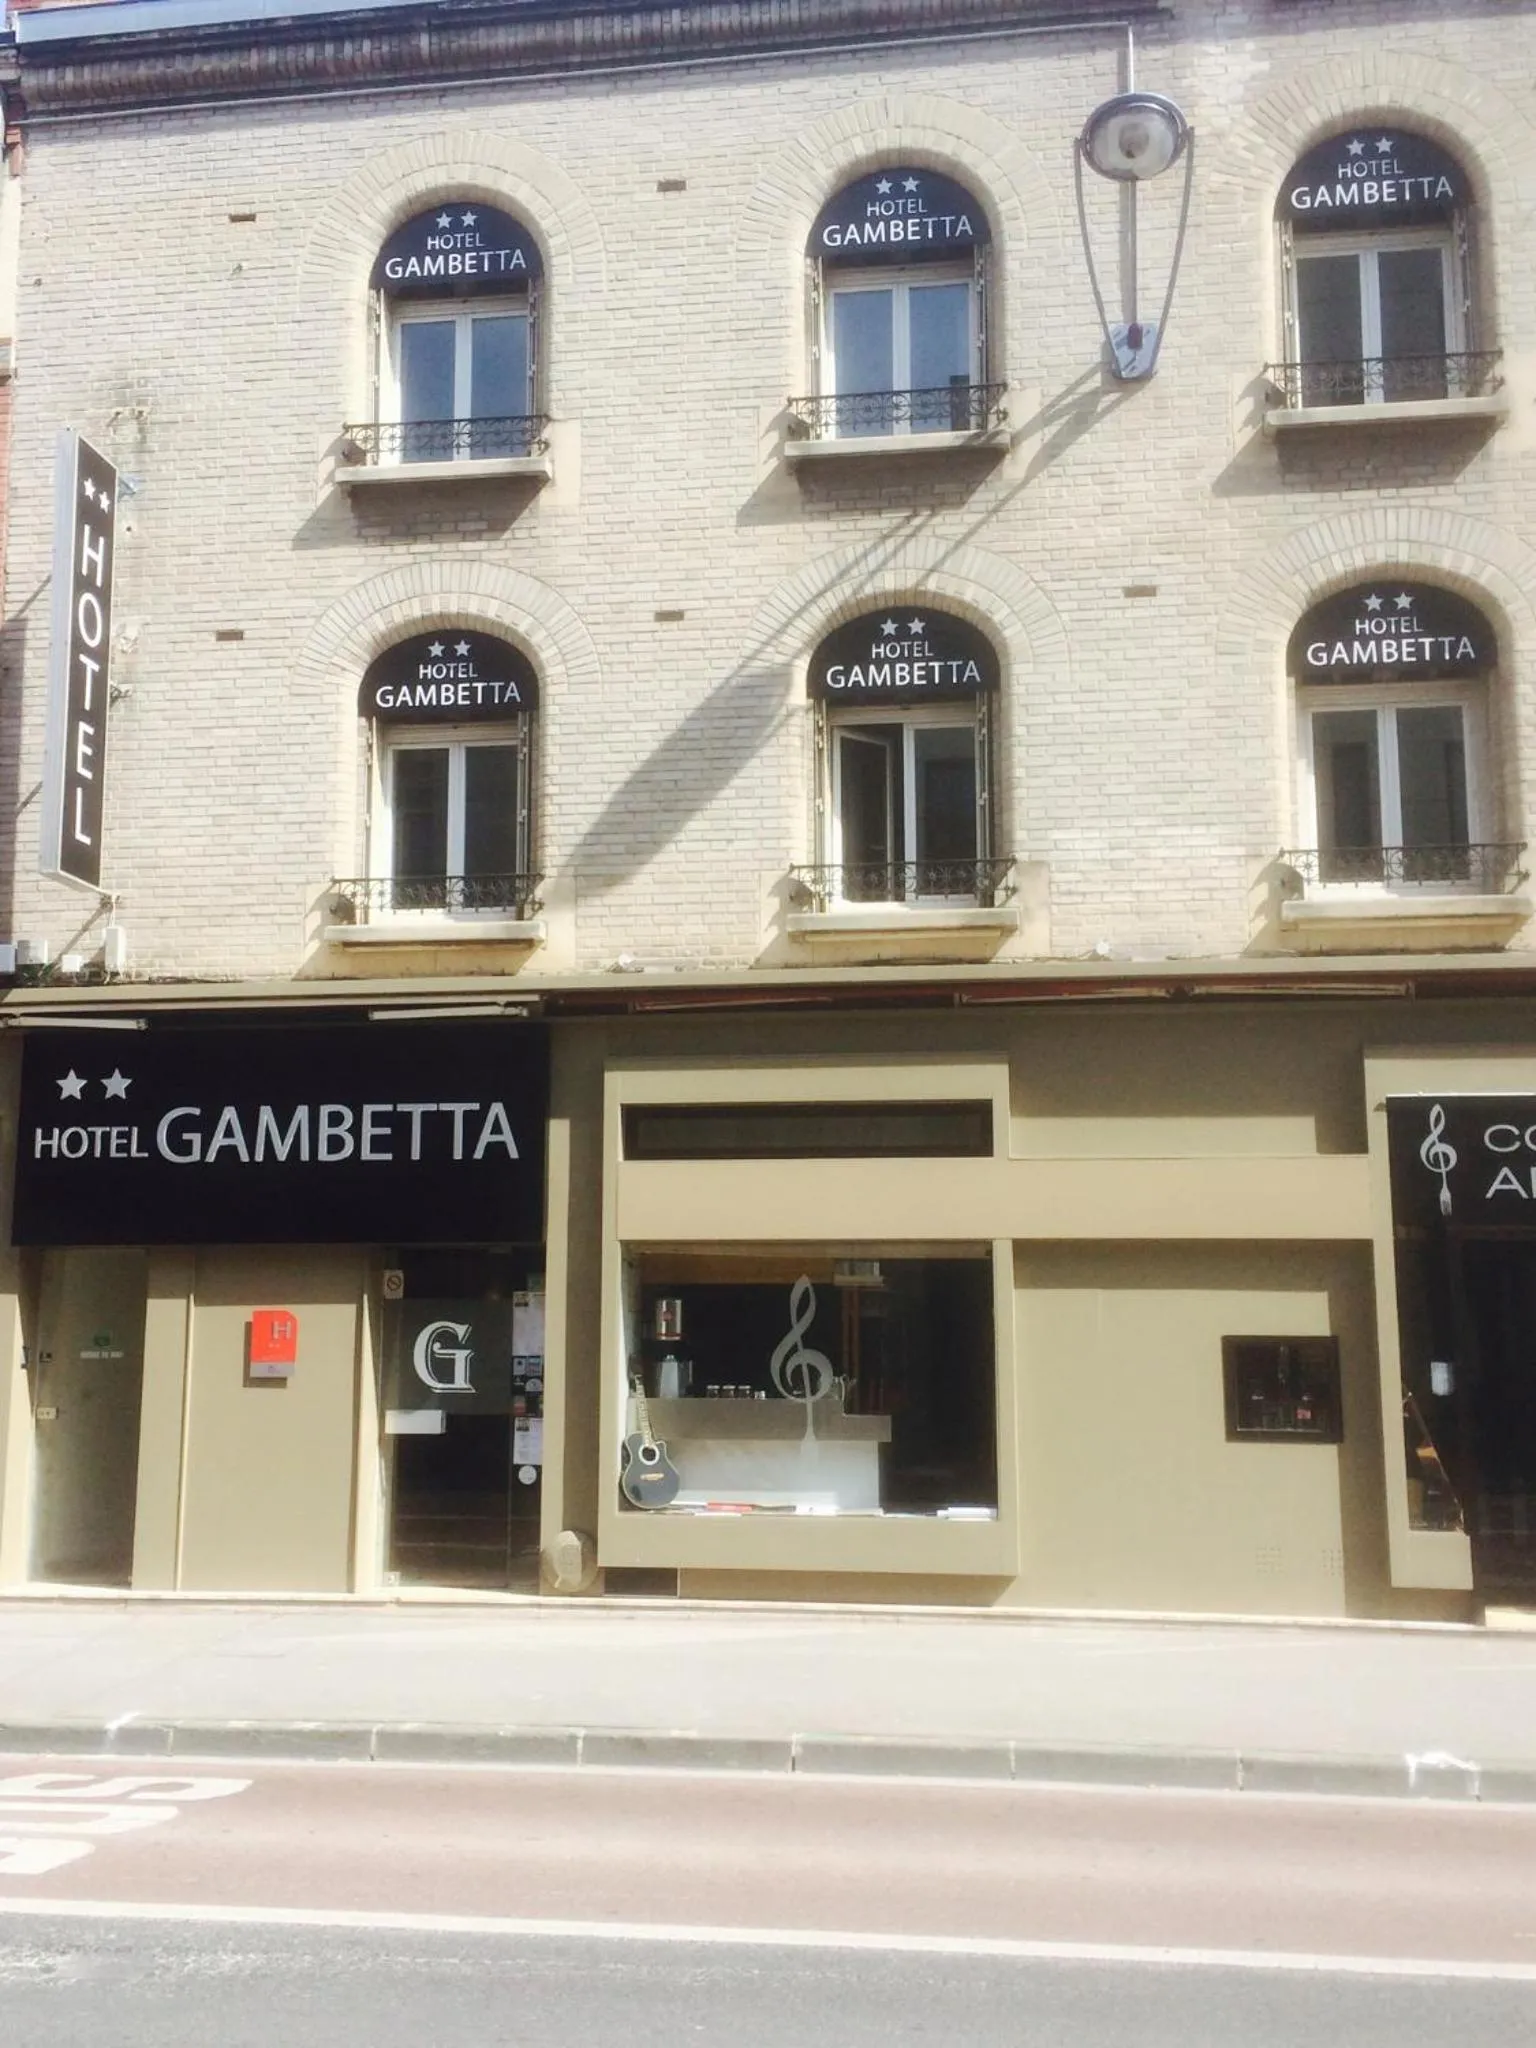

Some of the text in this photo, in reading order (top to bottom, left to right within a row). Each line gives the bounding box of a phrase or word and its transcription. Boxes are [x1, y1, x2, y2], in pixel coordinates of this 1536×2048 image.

[1338, 159, 1404, 179] HOTEL
[1290, 176, 1453, 209] GAMBETTA
[866, 198, 928, 217] HOTEL
[426, 232, 486, 251] HOTEL
[822, 215, 973, 247] GAMBETTA
[385, 248, 526, 279] GAMBETTA
[1355, 616, 1424, 636] HOTEL
[871, 640, 934, 659] HOTEL
[1306, 636, 1476, 667] GAMBETTA
[74, 524, 105, 846] HOTEL
[418, 662, 478, 680] HOTEL
[826, 660, 982, 689] GAMBETTA
[375, 681, 521, 708] GAMBETTA
[34, 1102, 519, 1163] HOTEL GAMBETTA
[413, 1320, 476, 1393] G
